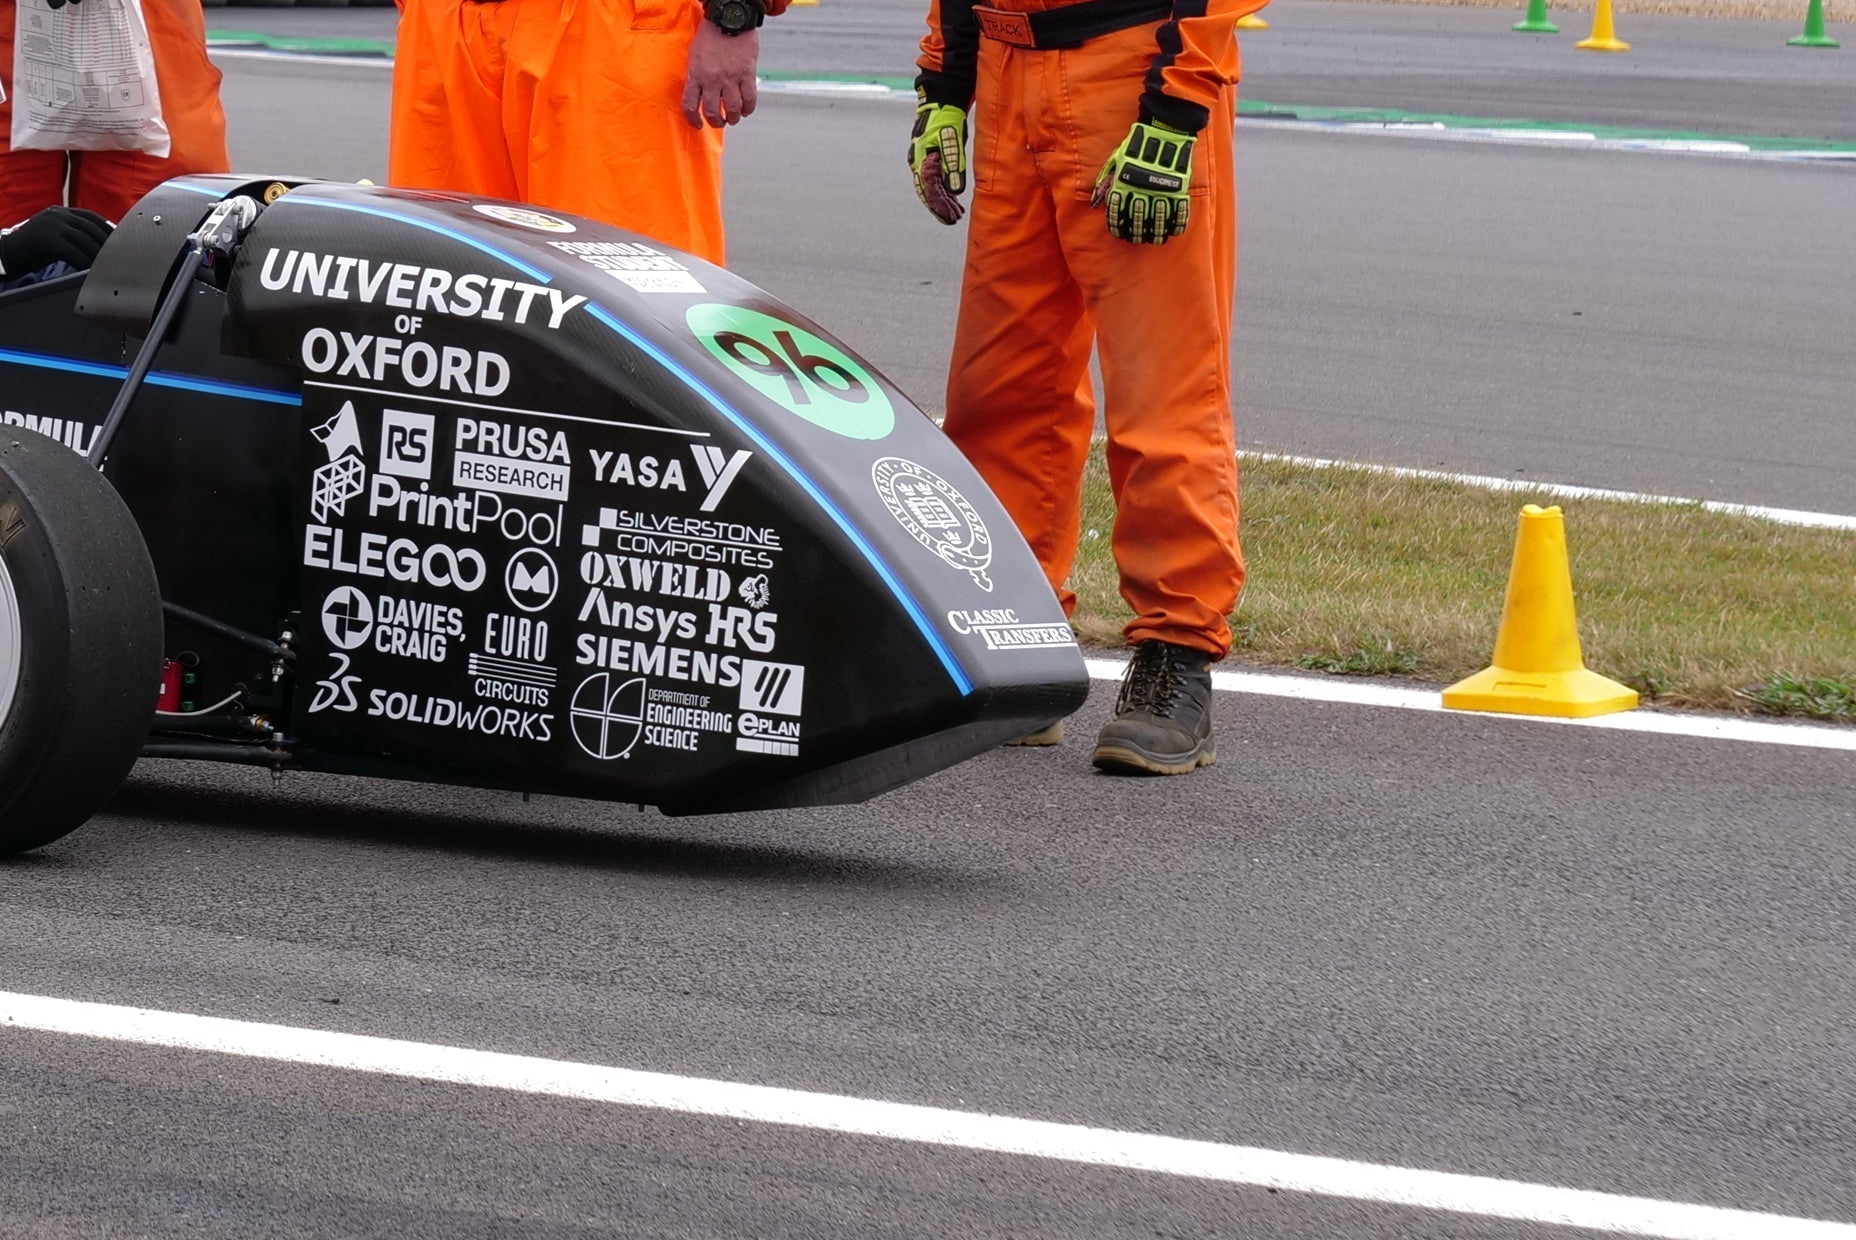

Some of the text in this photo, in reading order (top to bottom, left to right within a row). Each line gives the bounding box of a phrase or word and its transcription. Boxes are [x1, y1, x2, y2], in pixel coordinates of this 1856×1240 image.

[984, 19, 1024, 38] TRACK
[259, 247, 588, 330] UNIVERSITY
[394, 314, 422, 336] OF
[302, 327, 511, 397] OXFORD
[712, 329, 870, 406] 96
[386, 423, 428, 464] RS
[455, 417, 571, 465] PRUSA
[459, 461, 564, 492] RESEARCH
[588, 449, 687, 492] YASA
[369, 474, 564, 548] PrintPool
[619, 509, 781, 546] SILVERSTONE
[876, 461, 988, 547] UNIVERSITY OF OXFORD
[303, 523, 487, 592] ELEGOO
[617, 534, 774, 569] COMPOSITES
[580, 551, 732, 602] OXWELD
[377, 594, 466, 642] DAVIES,
[484, 612, 549, 661] EURO
[577, 587, 698, 643] Ansys
[374, 625, 447, 662] CRAIG
[575, 632, 742, 688] SIEMENS
[367, 688, 555, 742] SOLIDWORKS
[474, 677, 550, 707] CIRCUITS
[648, 688, 711, 708] DEPARTMENT OF
[644, 725, 699, 751] SCIENCE
[646, 703, 733, 734] ENGINEERING
